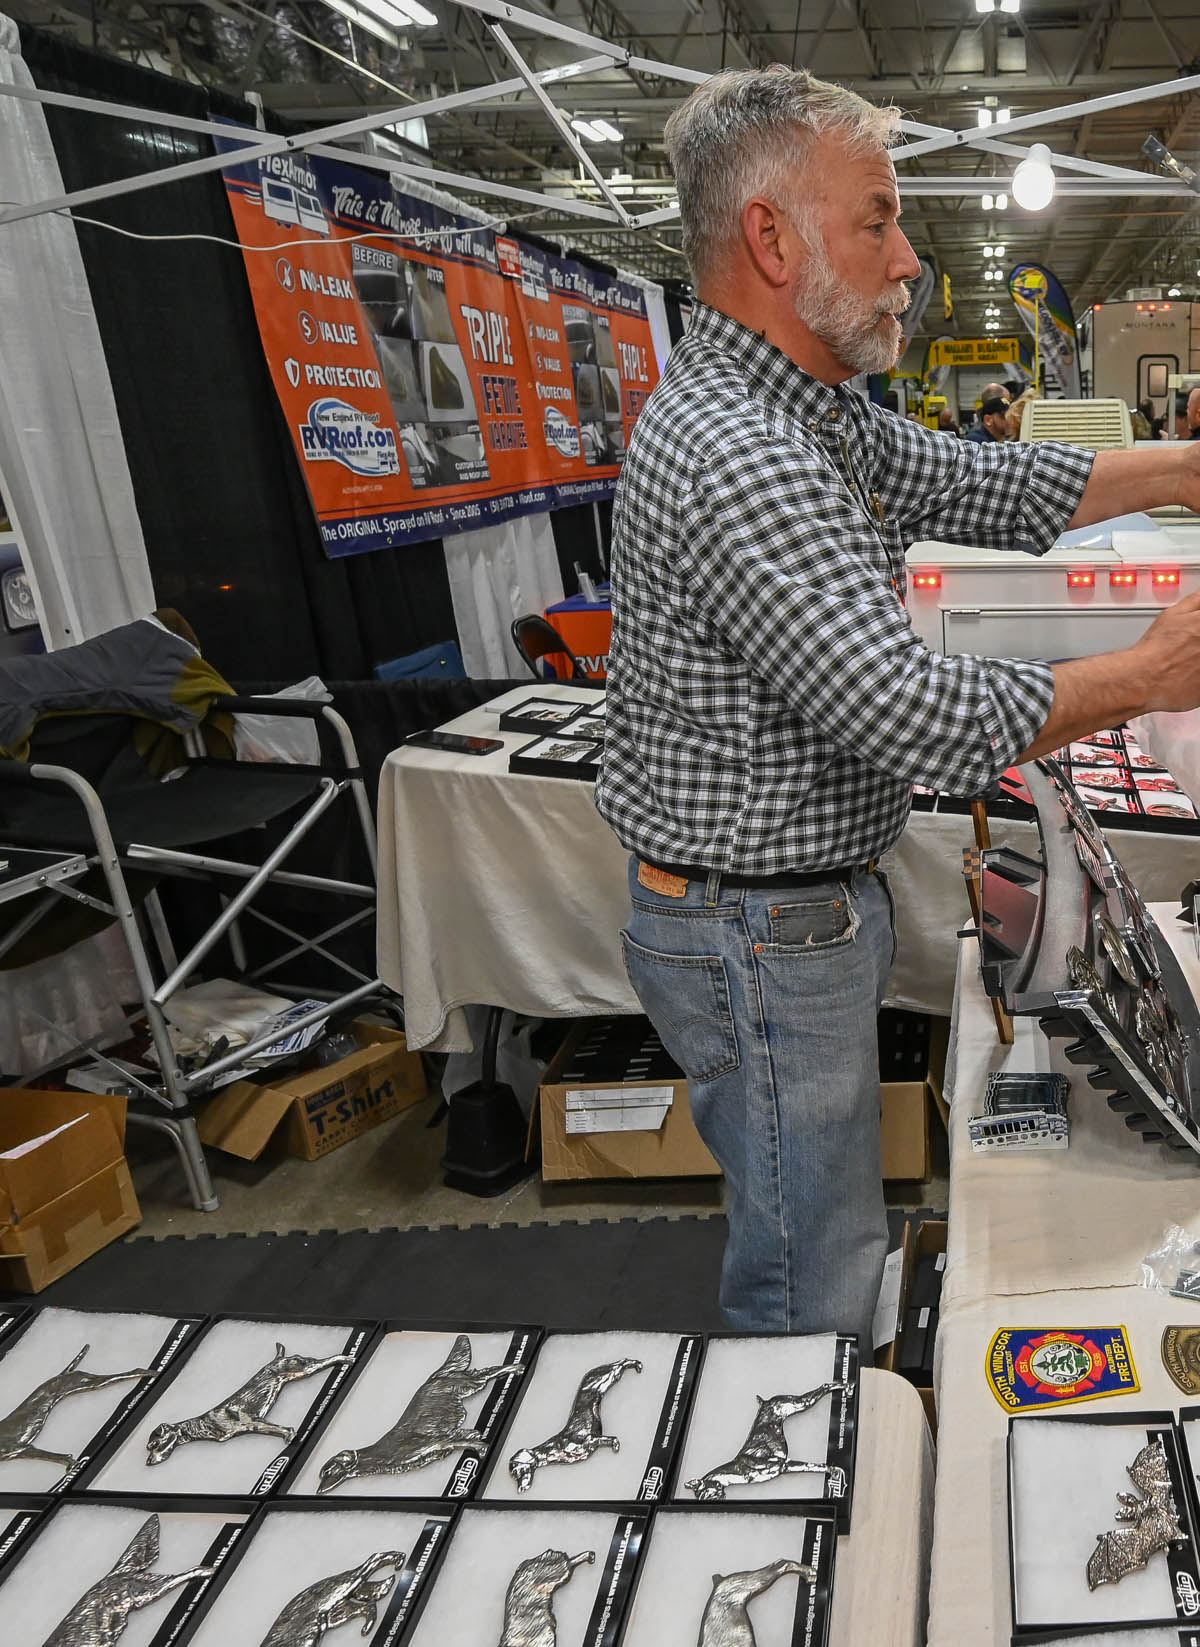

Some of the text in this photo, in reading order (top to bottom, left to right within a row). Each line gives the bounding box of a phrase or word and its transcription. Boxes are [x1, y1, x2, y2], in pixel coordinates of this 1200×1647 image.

[331, 185, 364, 218] This
[352, 247, 393, 269] BEFORE
[299, 269, 354, 300] NO-LEAK
[319, 321, 358, 345] VALUE
[460, 304, 514, 366] TRIPLE
[1125, 321, 1177, 330] MONTANA
[304, 363, 382, 389] PROTECTION
[337, 520, 382, 540] ORIGINAL
[382, 514, 416, 535] Sprayed
[309, 1080, 395, 1136] T-Shirt
[1111, 1335, 1132, 1382] FIRE DEPT.
[1167, 1329, 1178, 1363] WINDSOR
[668, 1400, 679, 1421] designs
[676, 1339, 694, 1395] www.GRILLIE.com
[992, 1332, 1021, 1406] SOUTH WINDSOR
[1171, 1361, 1195, 1389] SOUTH
[449, 1457, 478, 1496] grillie
[389, 1608, 407, 1635] designs
[405, 1525, 442, 1600] www.GRILLIE.com
[597, 1605, 611, 1633] designs
[608, 1521, 633, 1597] www.GRILLIE.com
[805, 1604, 816, 1633] designs
